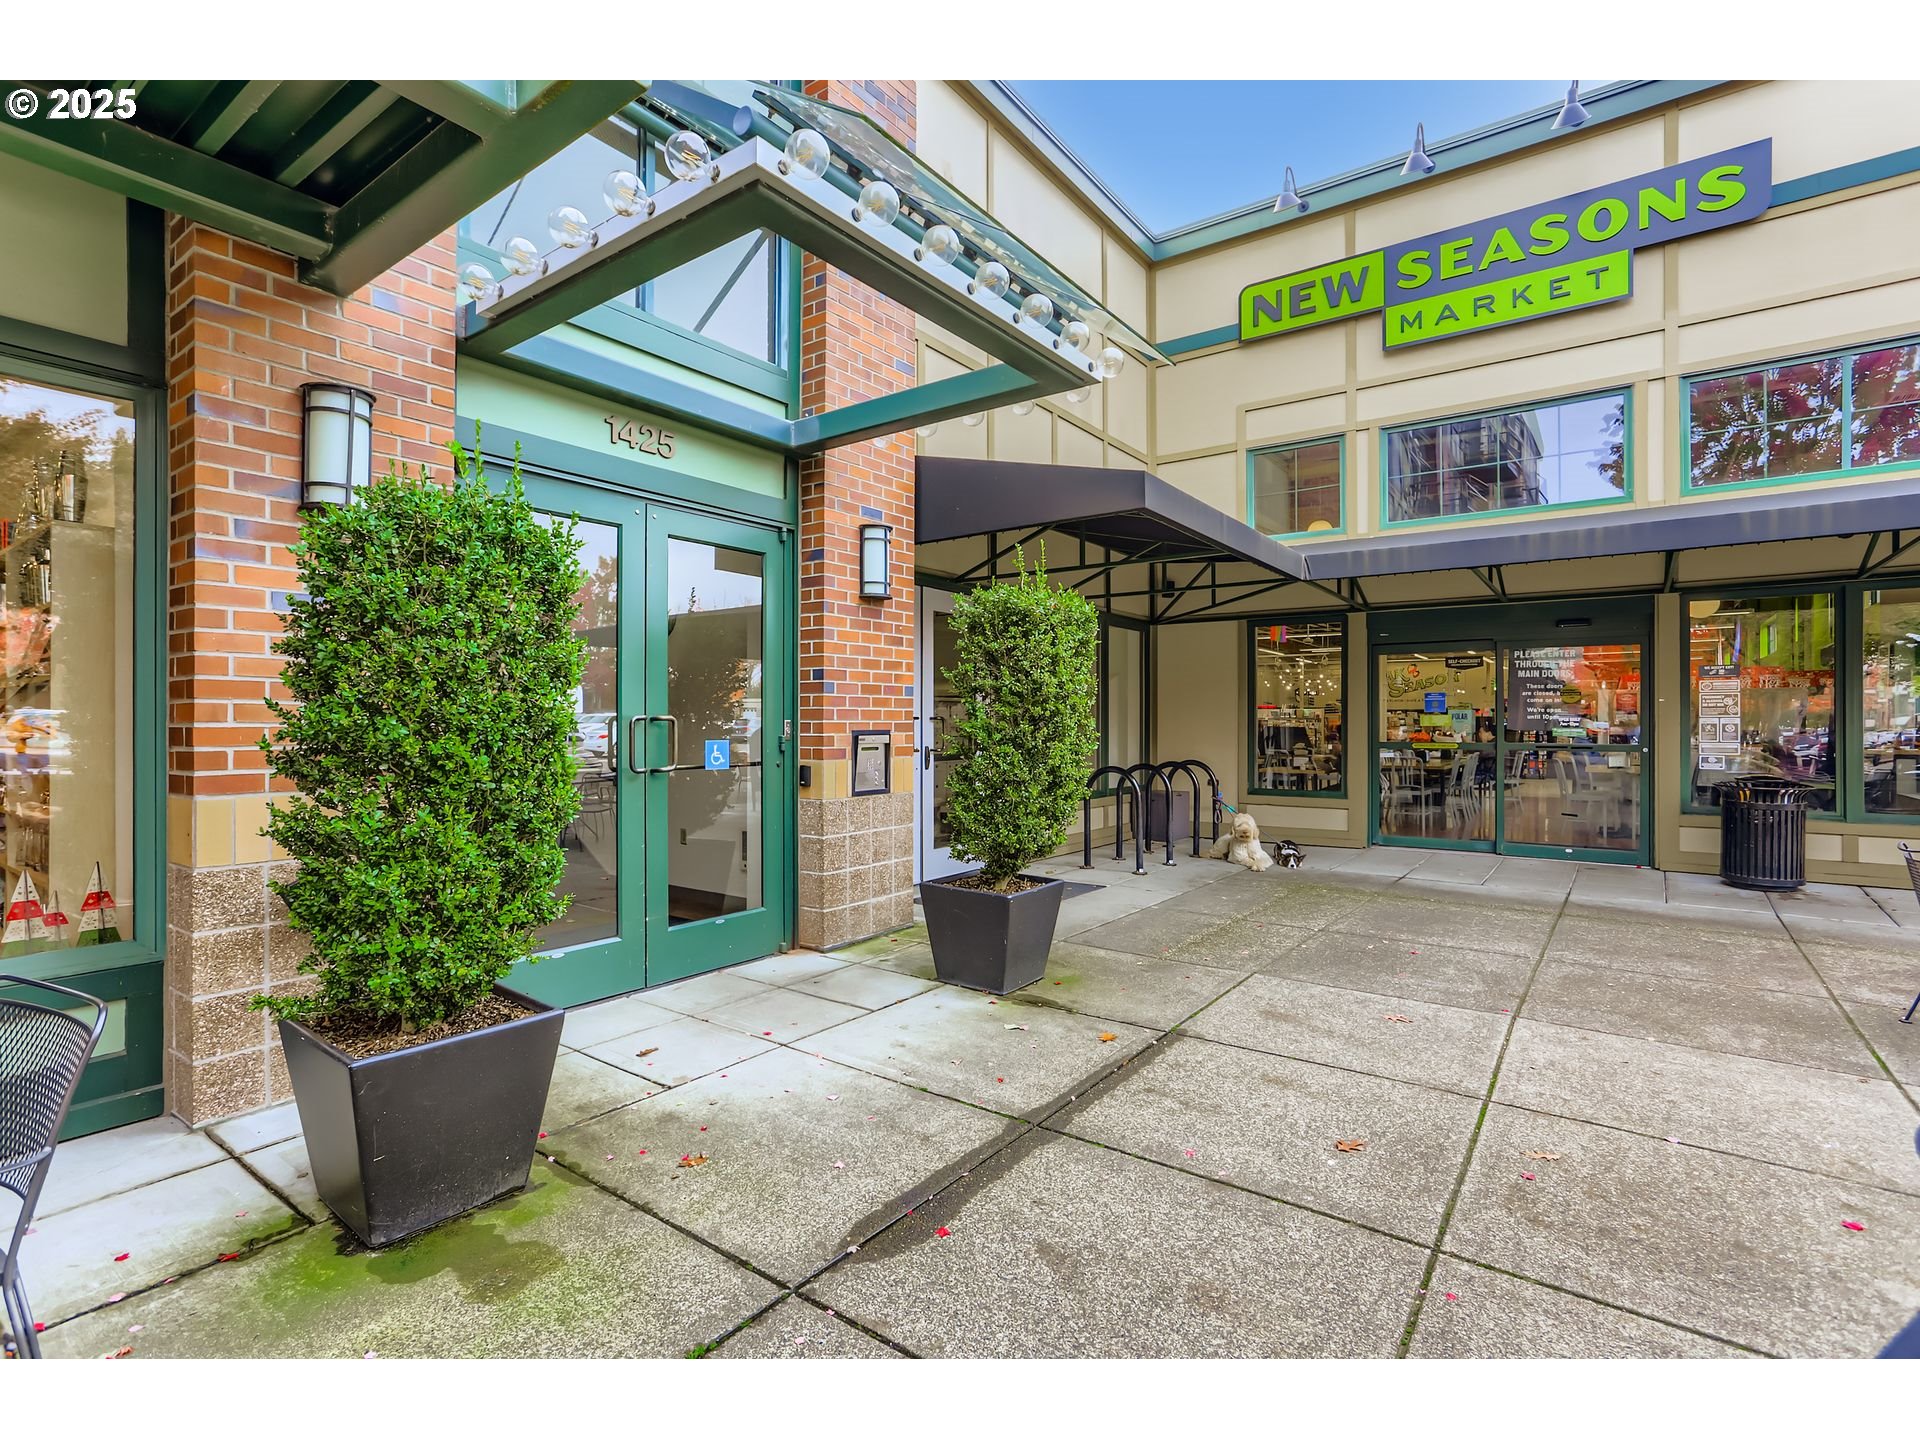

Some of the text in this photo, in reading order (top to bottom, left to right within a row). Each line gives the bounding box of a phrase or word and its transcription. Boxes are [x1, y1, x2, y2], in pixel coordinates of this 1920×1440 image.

[1252, 165, 1747, 328] NEW SEASONS
[1400, 265, 1610, 334] MARKET
[604, 415, 677, 459] 1425
[1514, 649, 1576, 658] PLEASE ENTER
[1514, 660, 1576, 668] THROUGH THE
[1517, 670, 1540, 678] MAIN
